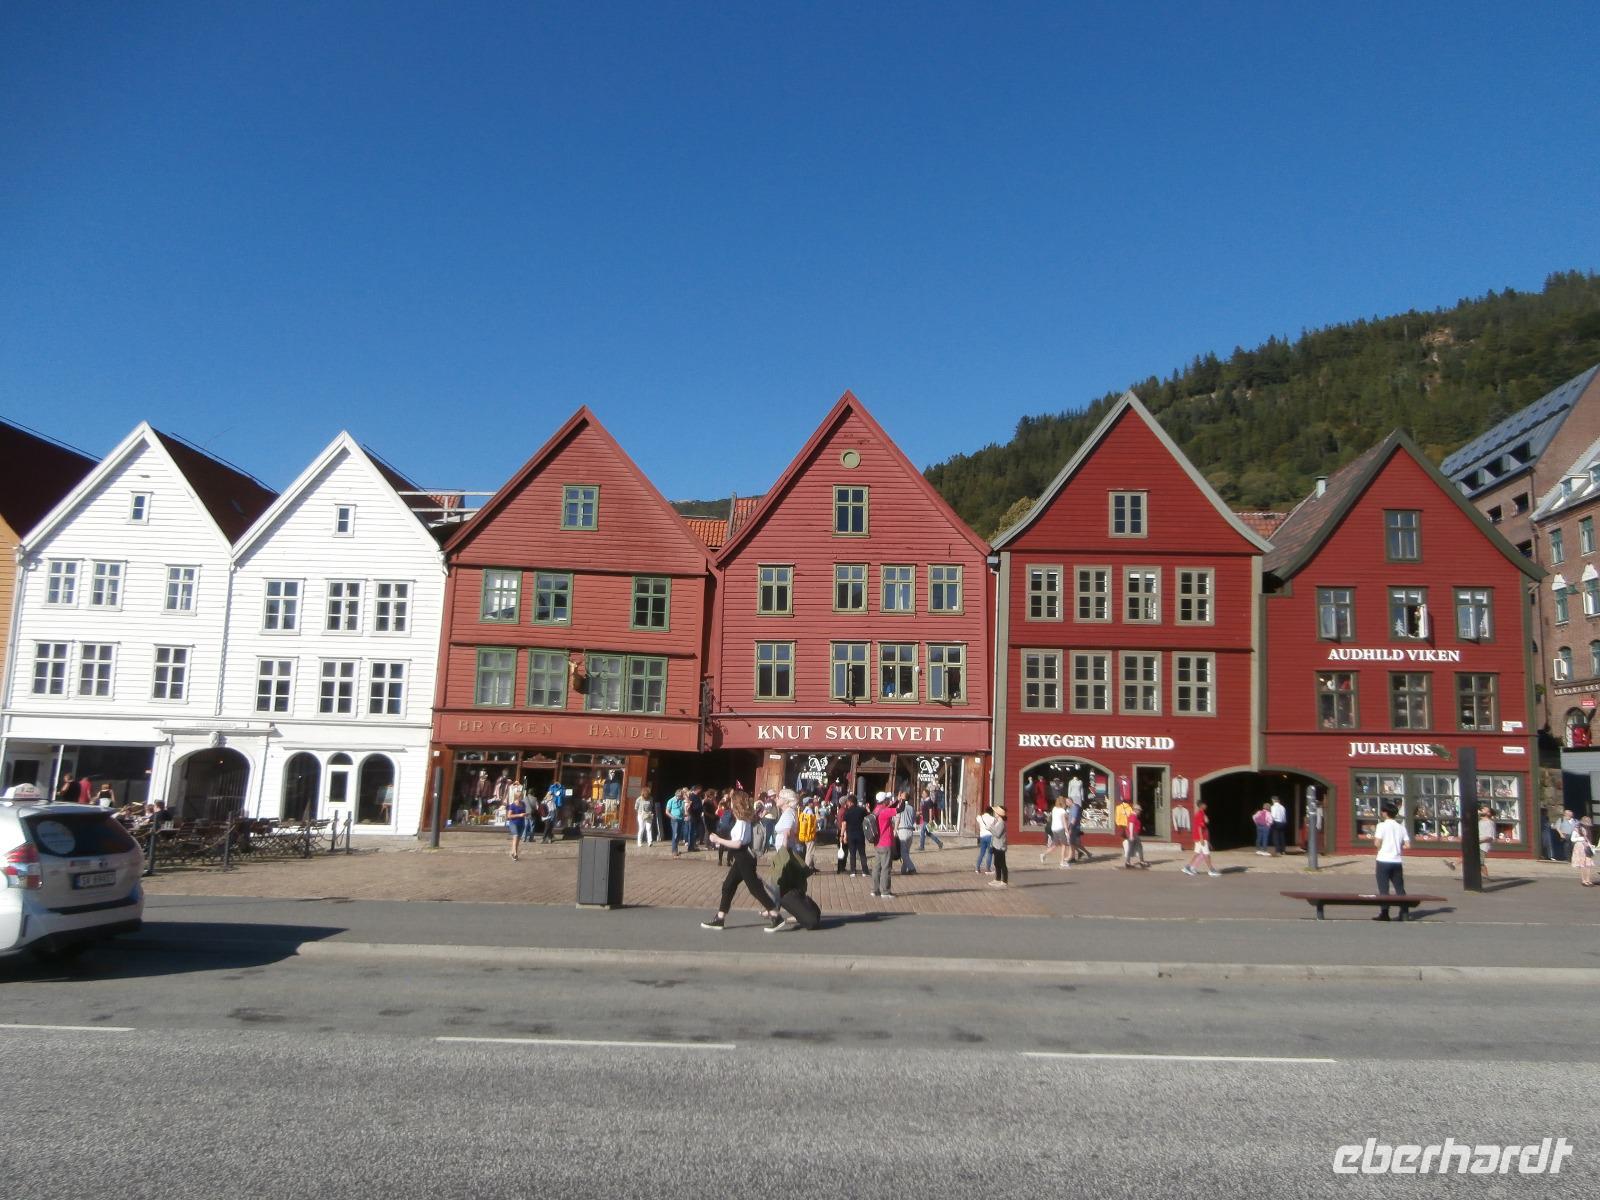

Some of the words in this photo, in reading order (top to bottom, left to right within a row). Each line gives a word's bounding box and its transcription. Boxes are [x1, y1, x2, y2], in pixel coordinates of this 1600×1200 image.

[1328, 648, 1404, 662] AUDHILD
[1405, 649, 1461, 663] VIKEN
[457, 719, 554, 736] BRYGGEN
[588, 723, 670, 741] HANDEL
[757, 725, 812, 740] KNUT
[825, 725, 945, 742] SKURTVEIT
[1018, 734, 1096, 749] BRYGGEN
[1101, 735, 1176, 751] HUSFLID
[1348, 742, 1440, 757] JULEHUSE
